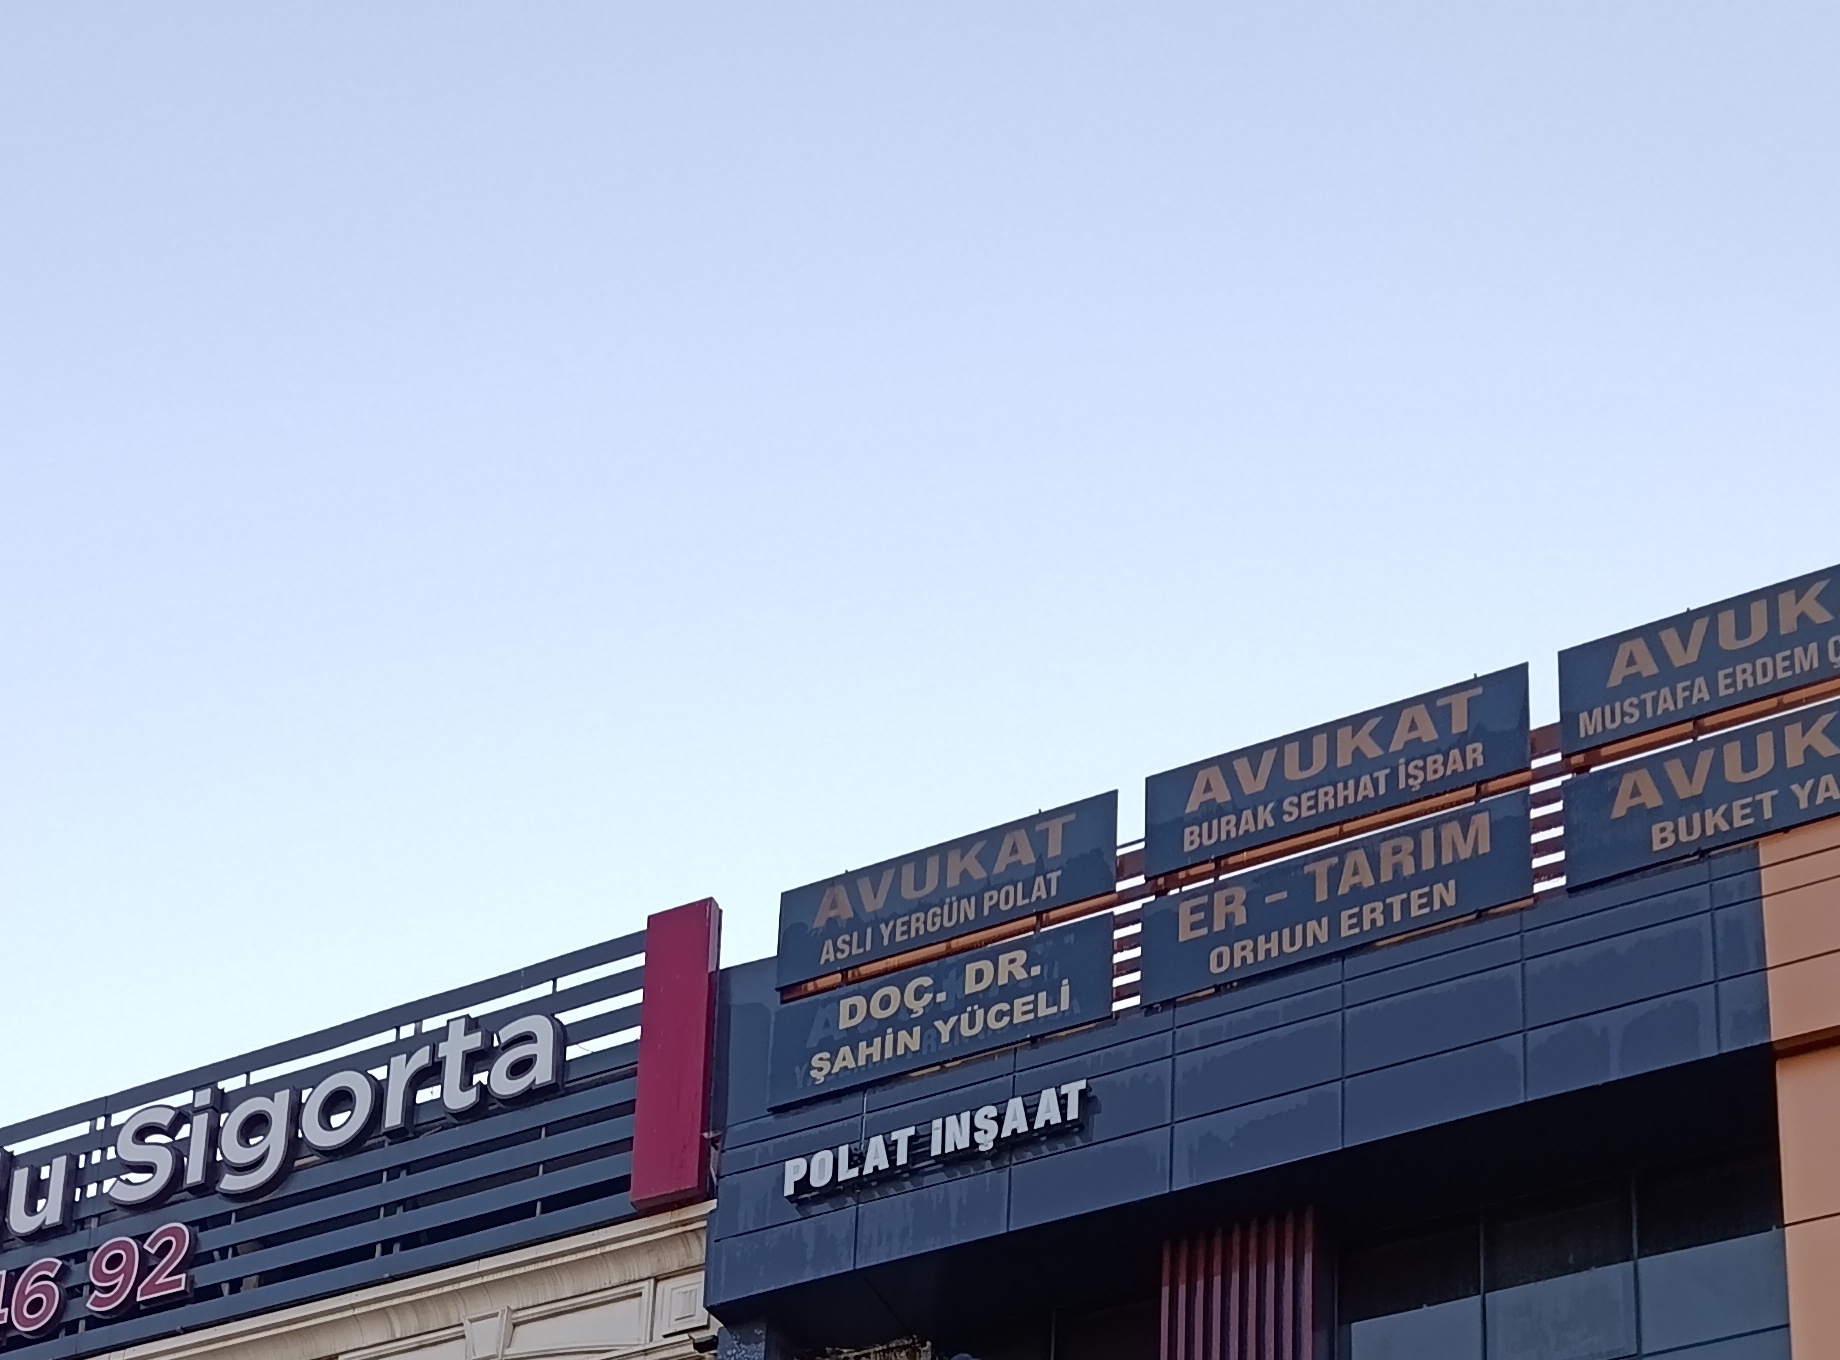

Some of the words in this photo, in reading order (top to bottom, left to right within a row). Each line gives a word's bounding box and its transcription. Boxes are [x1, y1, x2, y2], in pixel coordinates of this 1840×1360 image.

[1579, 679, 1710, 738] MUSTAFA
[1717, 639, 1820, 698] ERDEM
[1605, 577, 1835, 689] AVUK
[1183, 686, 1484, 814] AVUKAT
[1183, 804, 1275, 854] BURAK
[1282, 769, 1388, 824] SERHAT
[1397, 741, 1485, 792] İŞBAR
[1610, 709, 1840, 820] AVUK
[812, 813, 1076, 929] AVUKAT
[1652, 789, 1779, 852] BUKET
[819, 926, 874, 965] ASLI
[880, 897, 977, 950] YERGÜN
[982, 869, 1062, 911] POLAT
[1178, 884, 1247, 942] ER
[1304, 811, 1492, 896] TARIM
[1208, 916, 1329, 975] ORHUN
[1340, 878, 1457, 938] ERTEN
[809, 1026, 921, 1085] ŞAHİN
[933, 978, 1071, 1046] YÜCELİ
[838, 974, 947, 1030] DOÇ.
[965, 949, 1041, 995] DR.
[108, 1013, 562, 1206] Sigorta
[783, 1126, 917, 1198] POLAT
[930, 1078, 1089, 1160] İNŞAAT
[87, 1222, 192, 1313] 92
